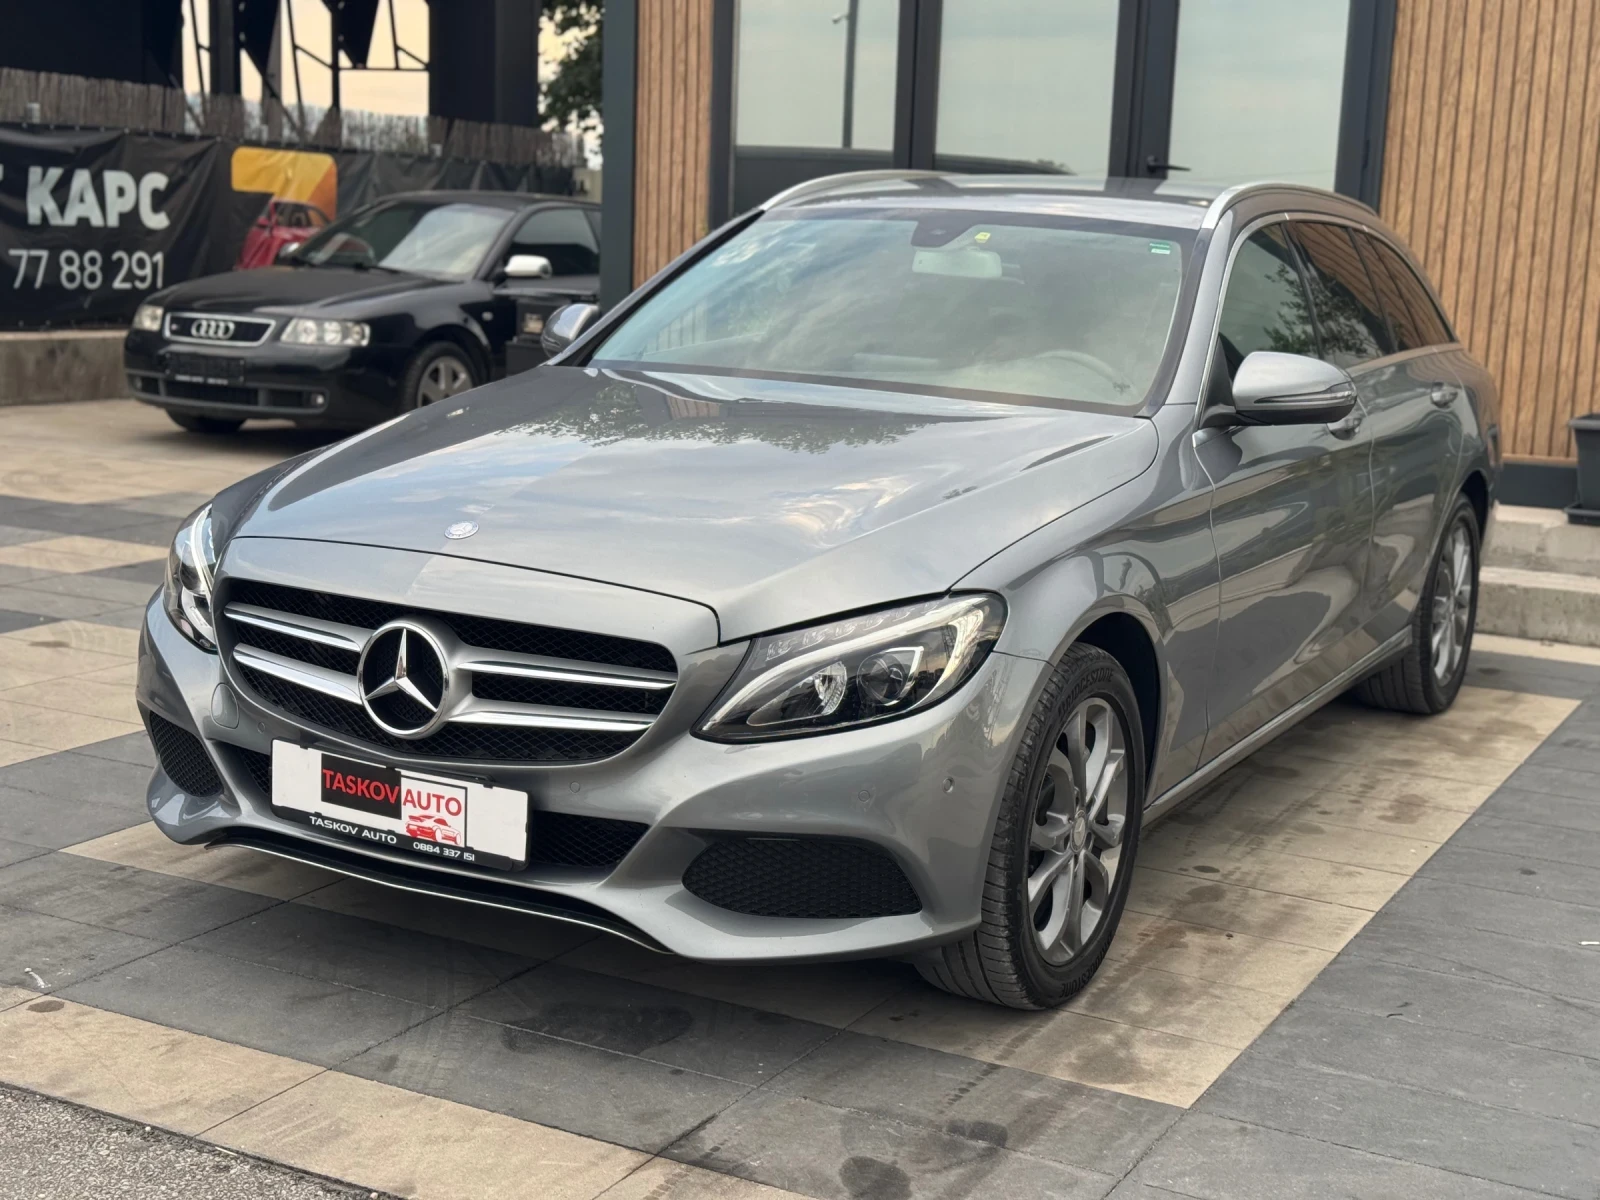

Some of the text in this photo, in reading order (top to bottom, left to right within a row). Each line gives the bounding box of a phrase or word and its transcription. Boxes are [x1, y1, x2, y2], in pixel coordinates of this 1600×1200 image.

[26, 166, 171, 231] КАРС
[8, 249, 165, 290] 77 88 291
[322, 769, 463, 817] TASKOV AUTO
[309, 815, 475, 861] TASKOV AUTO 0884 337 151
